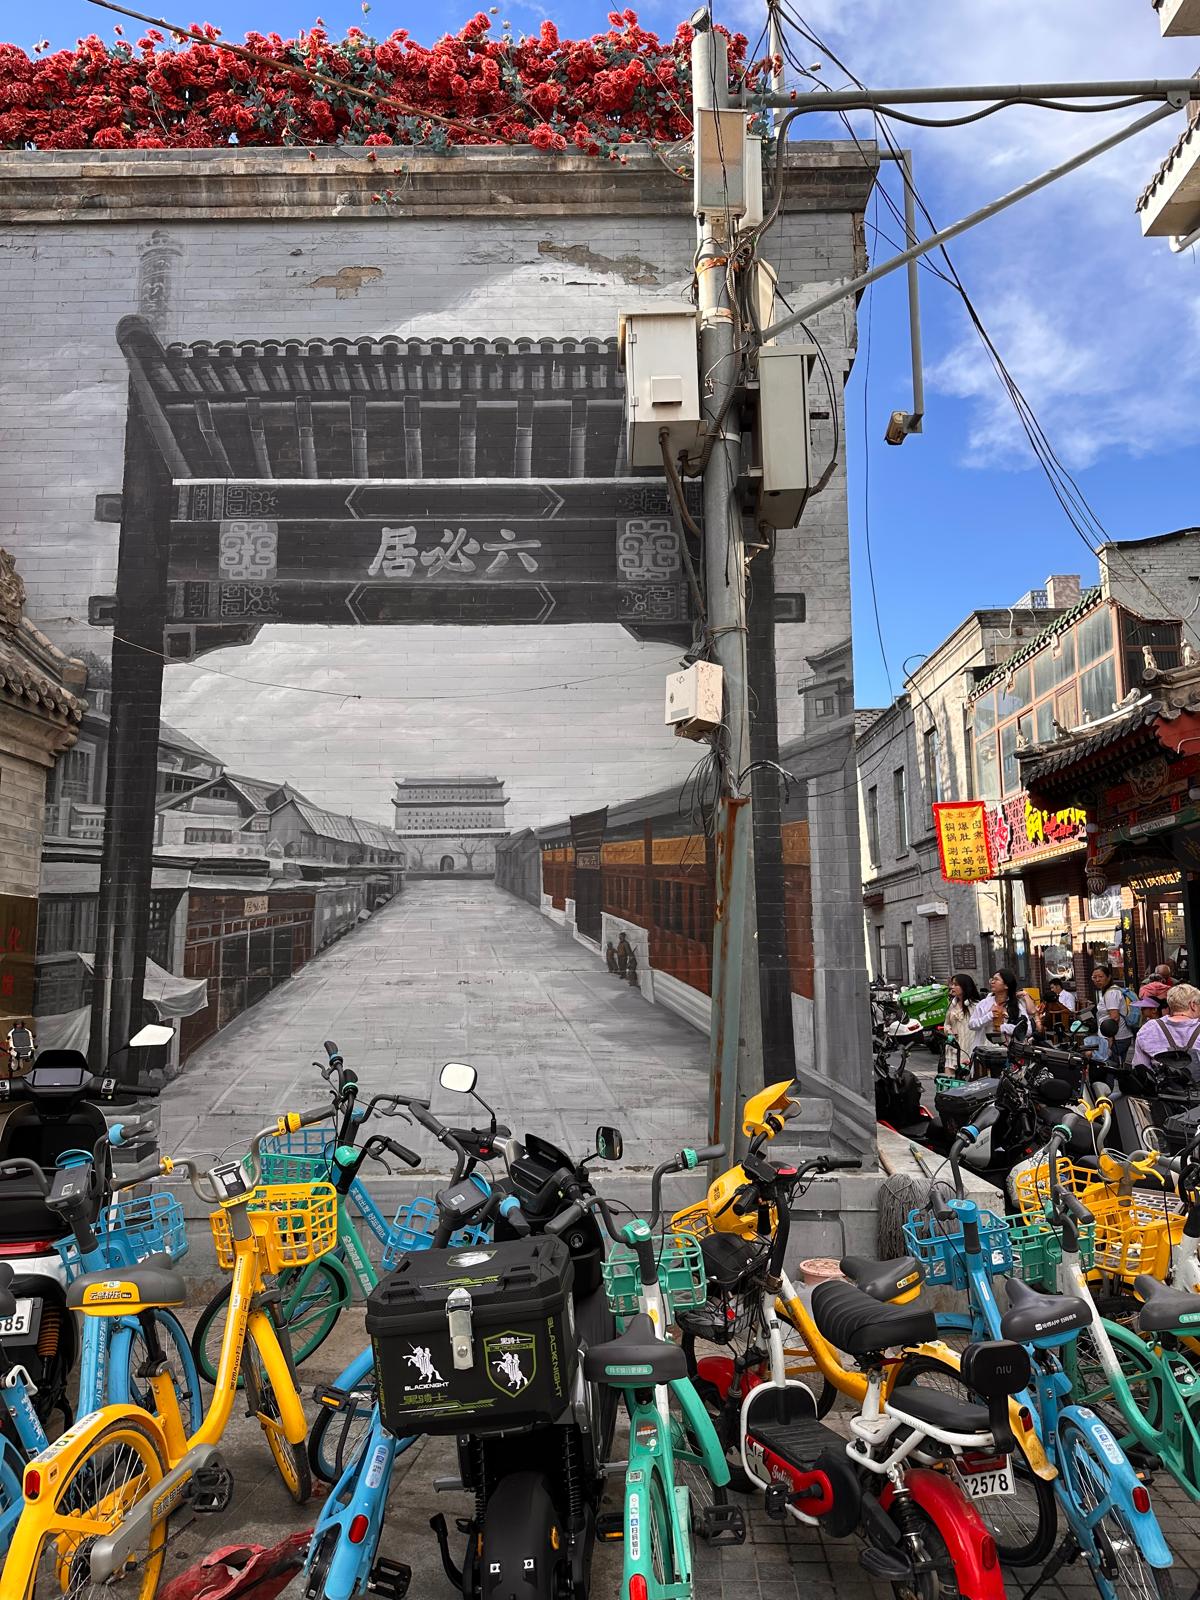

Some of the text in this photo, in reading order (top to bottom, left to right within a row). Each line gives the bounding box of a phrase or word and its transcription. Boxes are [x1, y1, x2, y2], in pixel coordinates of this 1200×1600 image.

[945, 811, 977, 819] 老北京
[0, 1316, 24, 1331] 85
[547, 1316, 562, 1397] BLACKNIGHT
[404, 1382, 450, 1391] BLACKNIGHT
